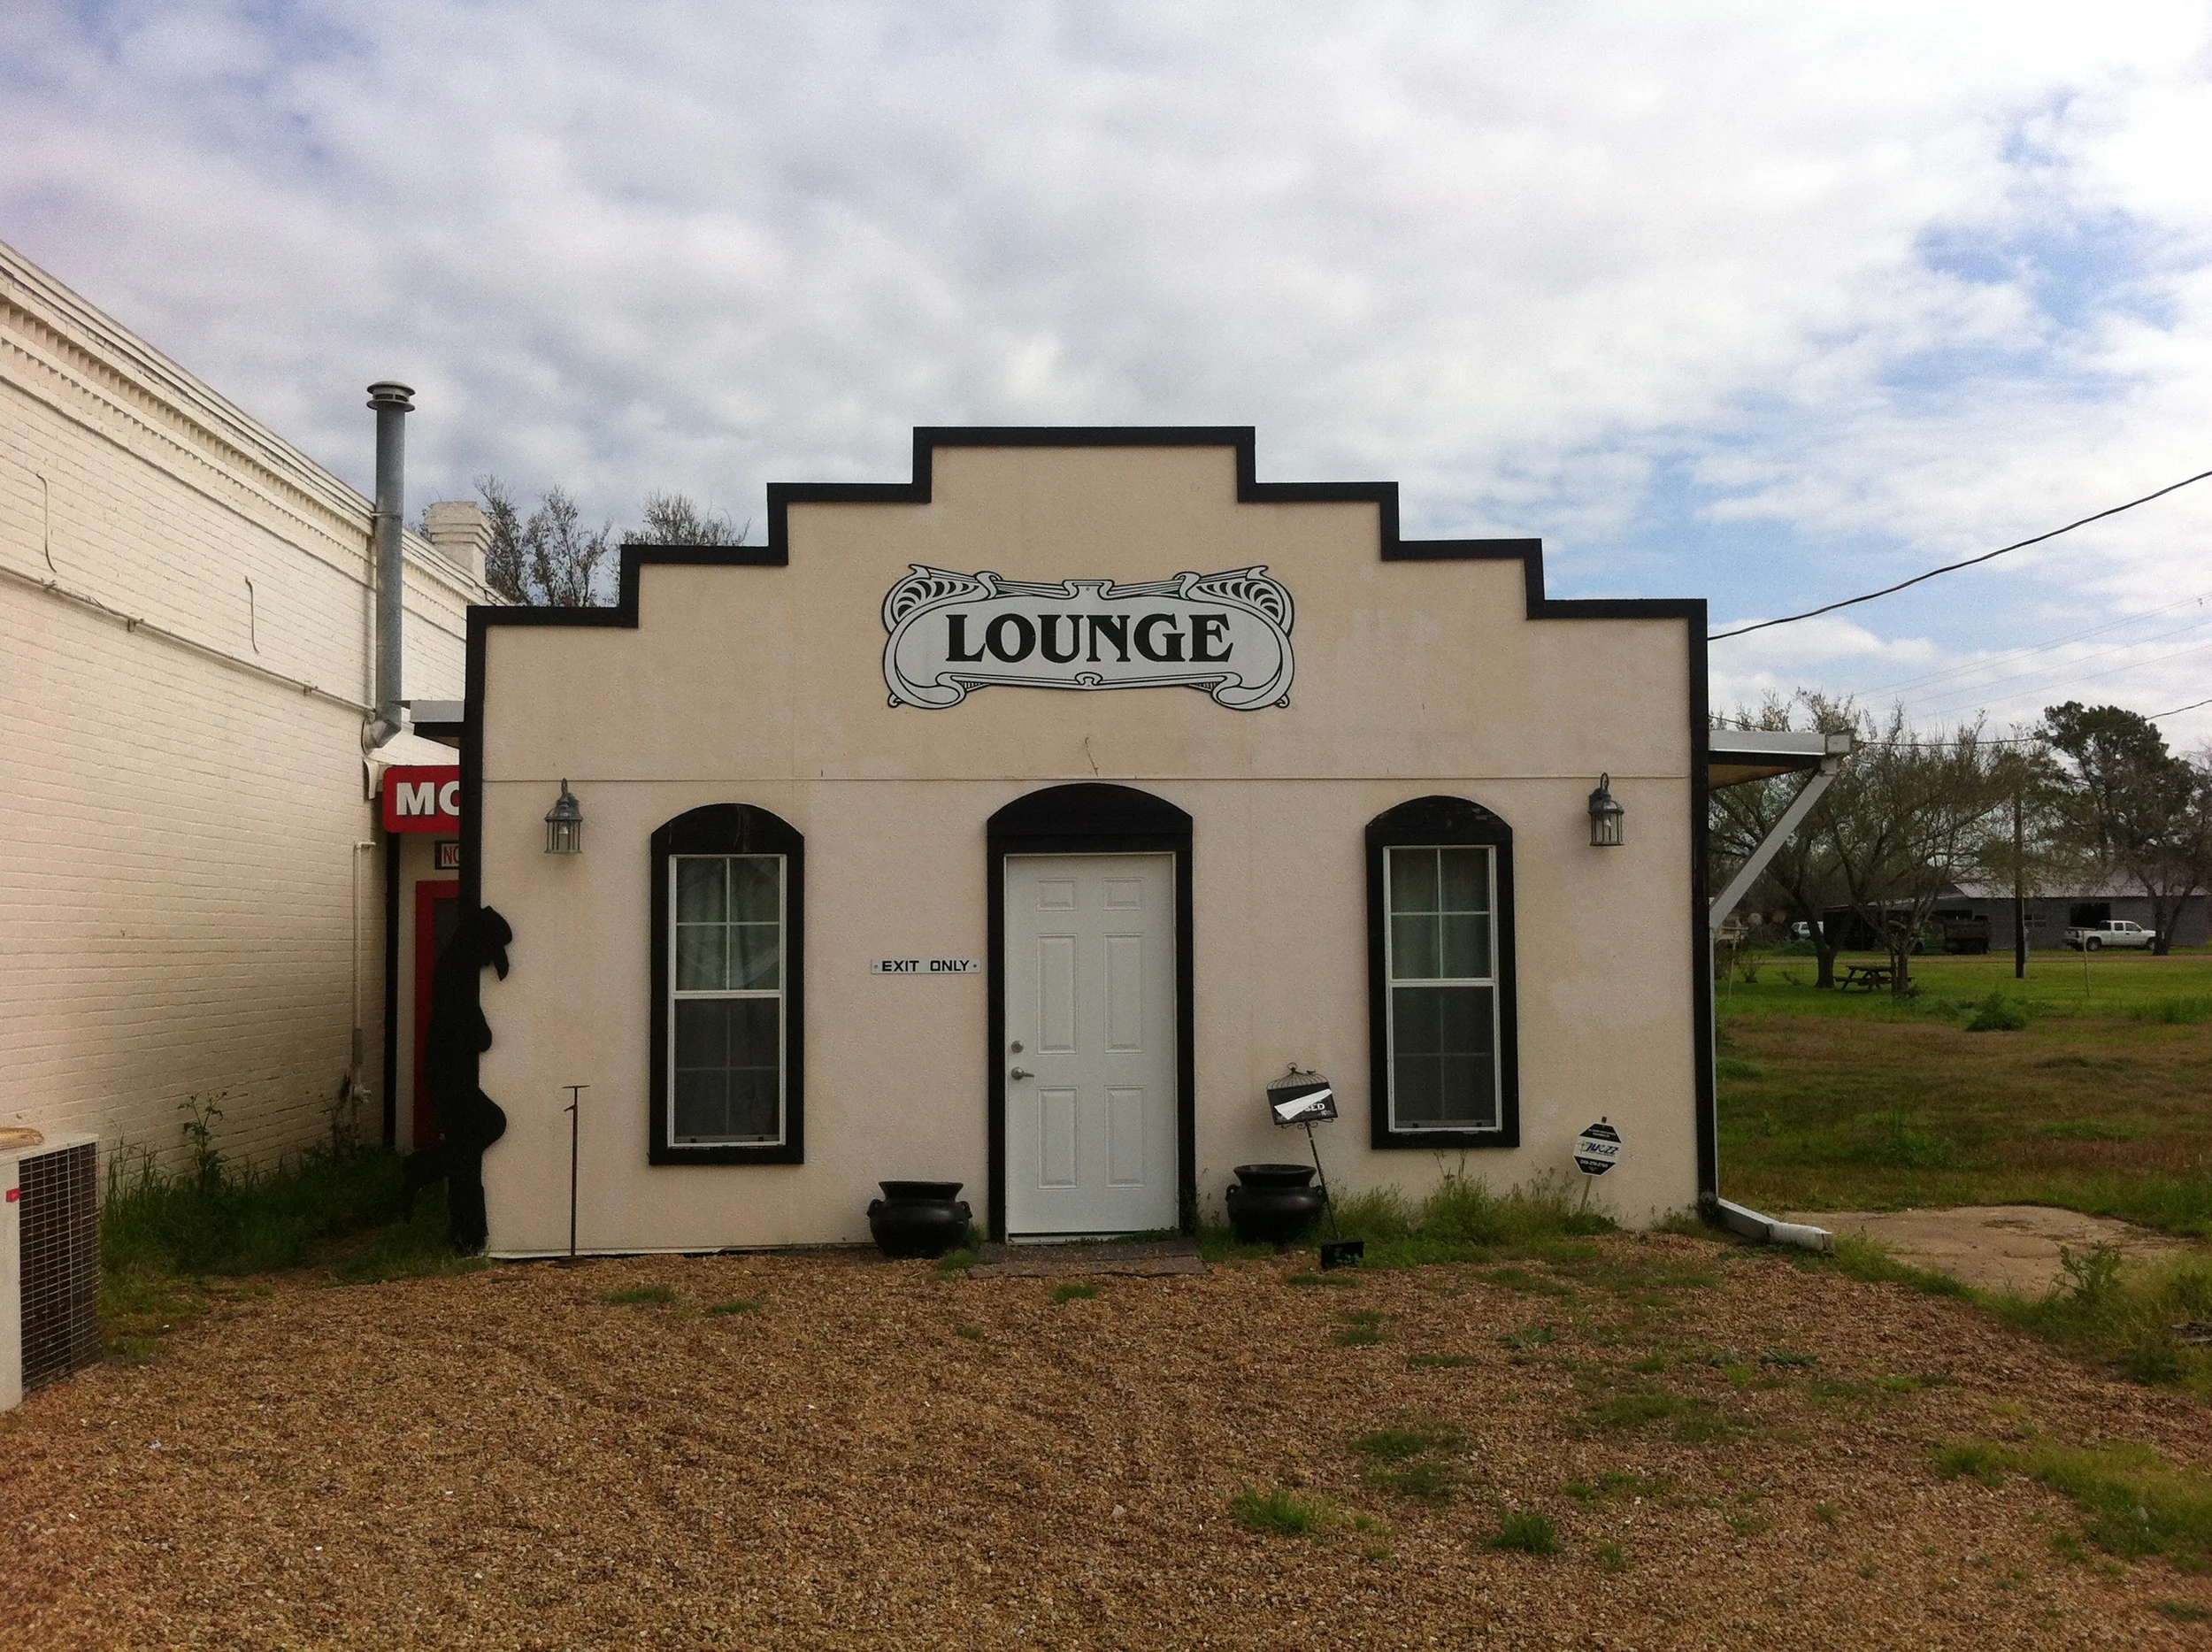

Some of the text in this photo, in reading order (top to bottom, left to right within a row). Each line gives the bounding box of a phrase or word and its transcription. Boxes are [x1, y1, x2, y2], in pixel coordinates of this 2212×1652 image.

[946, 613, 1233, 663] LOUNGE
[881, 959, 970, 972] EXIT ONLY
